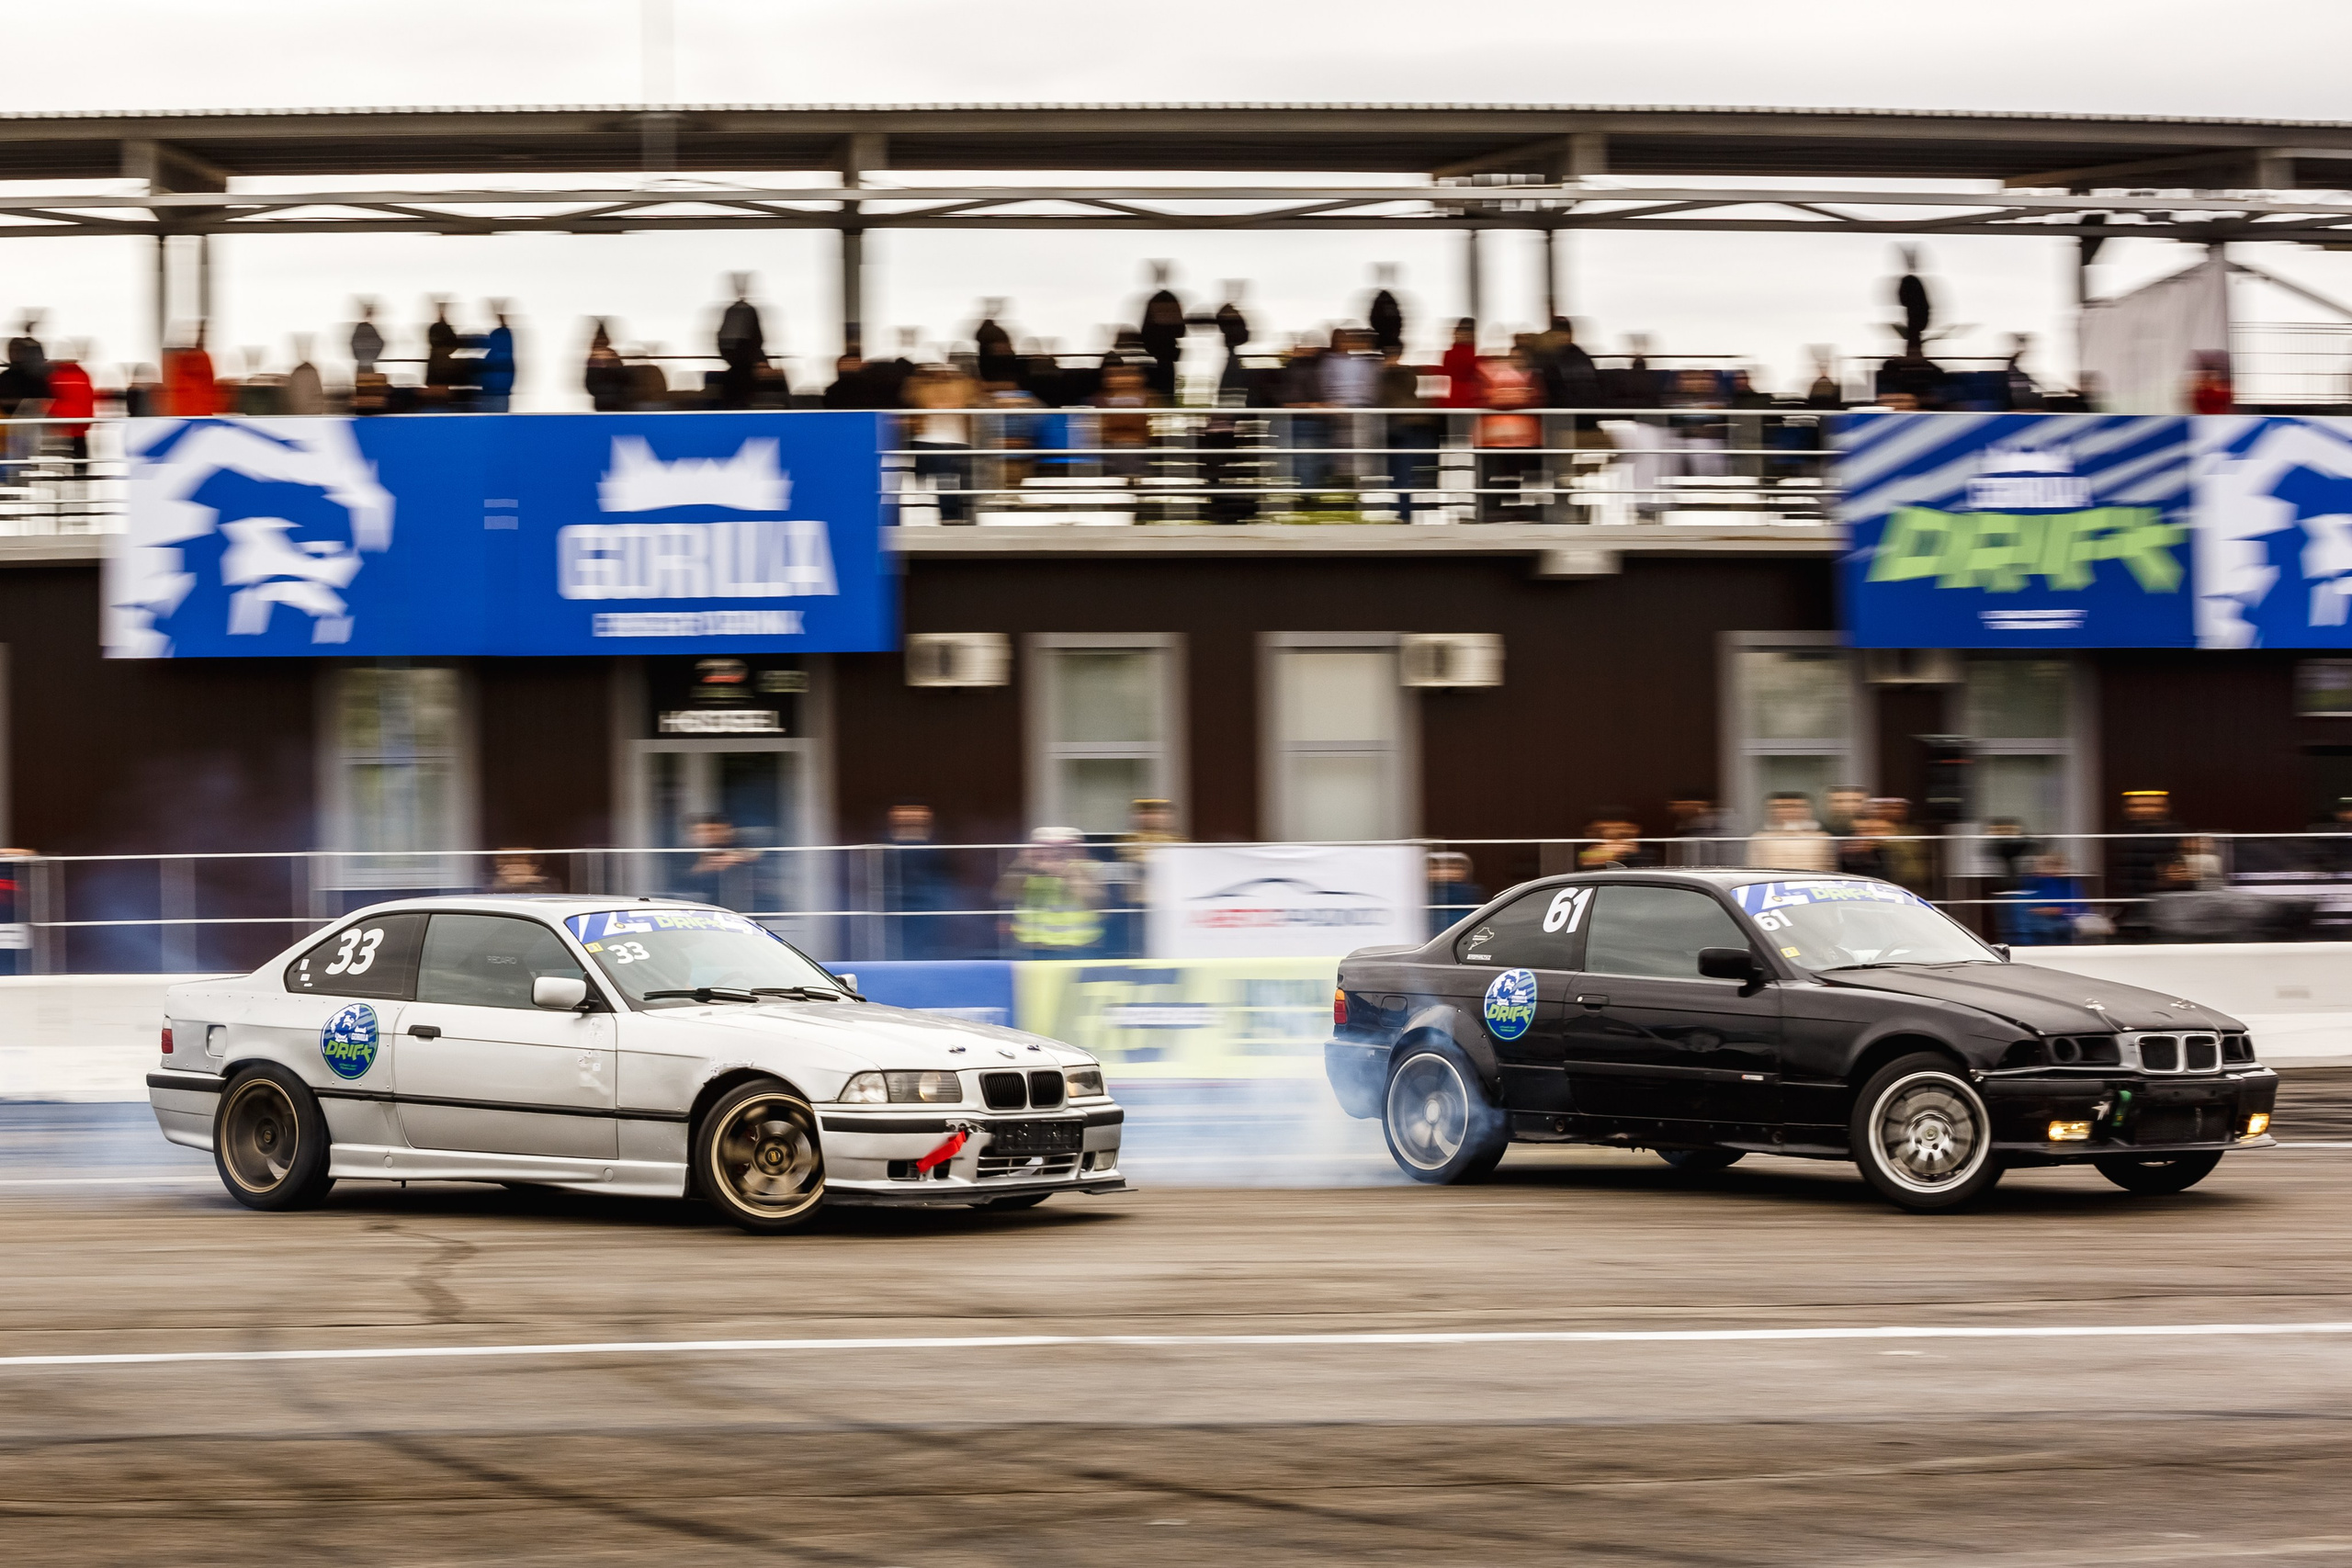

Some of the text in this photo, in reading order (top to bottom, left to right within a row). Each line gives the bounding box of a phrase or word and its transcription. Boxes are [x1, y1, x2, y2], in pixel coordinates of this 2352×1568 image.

[556, 520, 840, 600] GORILLA
[1543, 887, 1594, 933] 61
[1753, 909, 1793, 931] 61
[325, 928, 384, 975] 33
[487, 955, 517, 964] RECARO
[607, 942, 650, 964] 33
[1487, 1004, 1532, 1024] DRIFT
[324, 1040, 372, 1063] DRIFT
